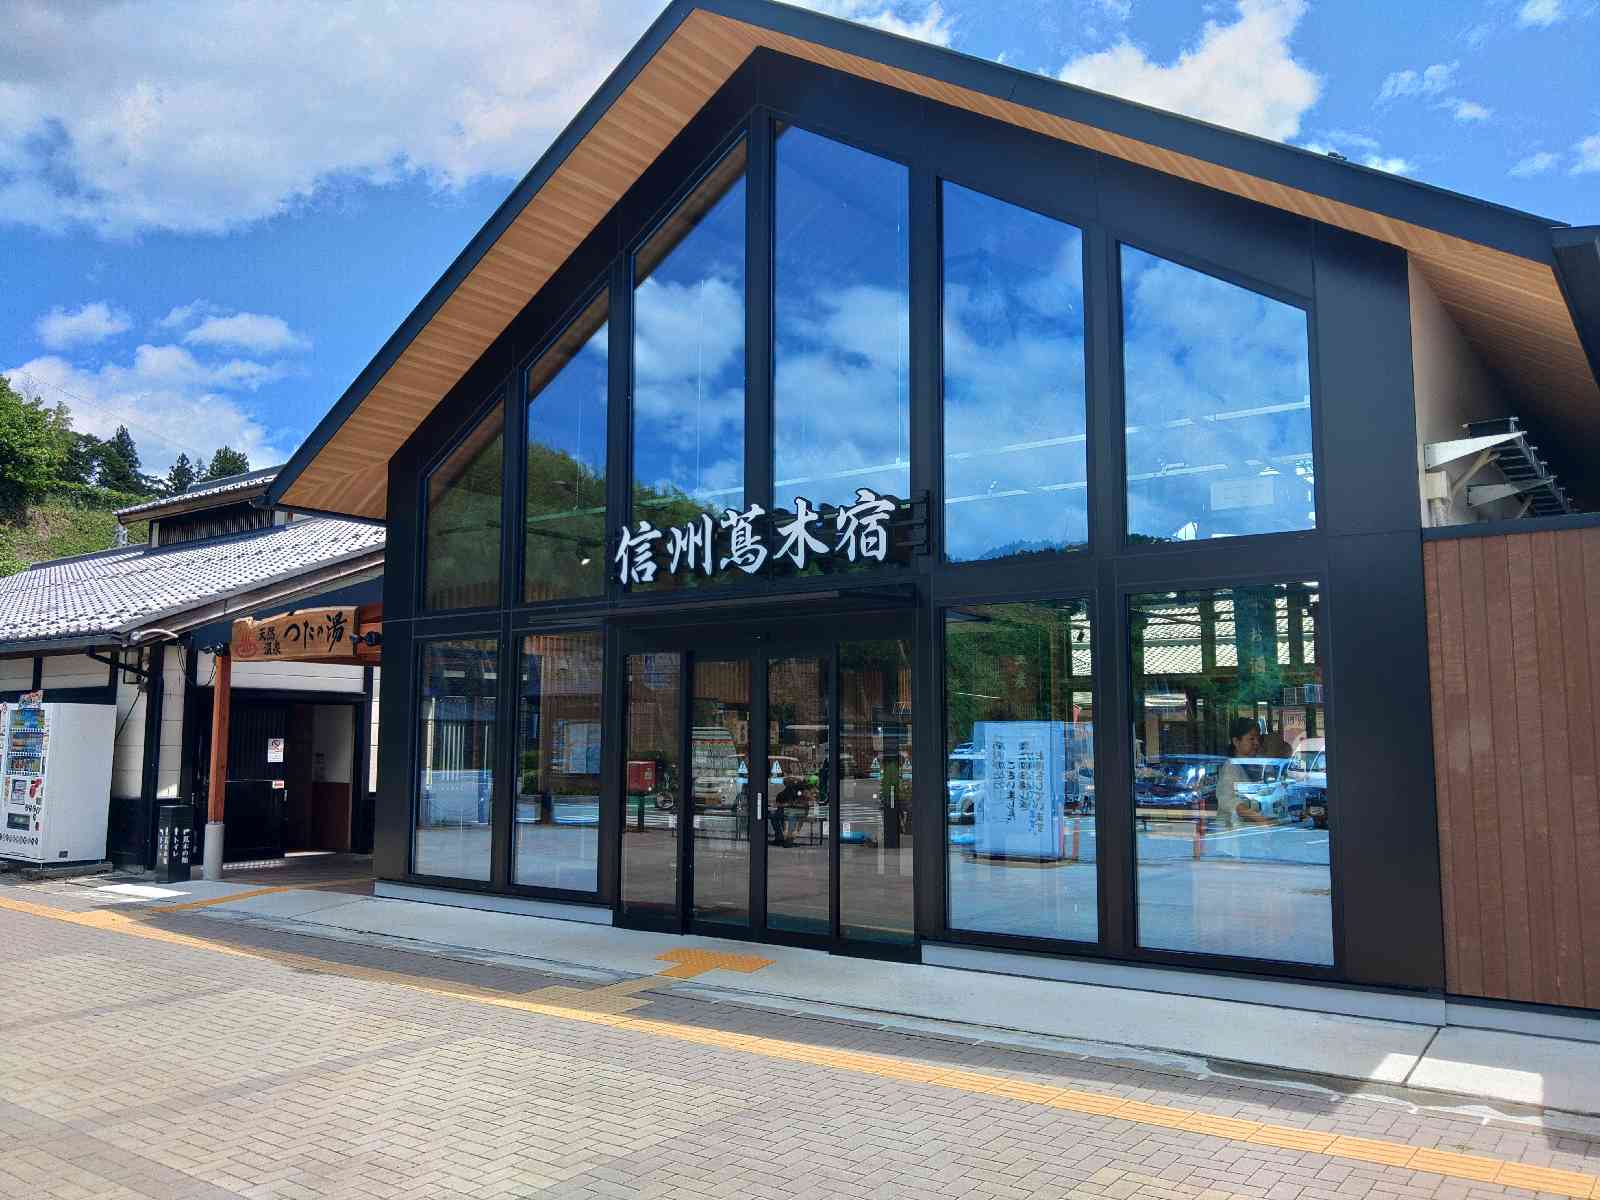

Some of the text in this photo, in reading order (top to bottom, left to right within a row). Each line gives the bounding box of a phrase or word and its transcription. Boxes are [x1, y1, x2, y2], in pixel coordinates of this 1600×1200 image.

[615, 488, 896, 584] 信州蔦木宿
[258, 626, 276, 640] 天然
[283, 611, 348, 652] つたの湯
